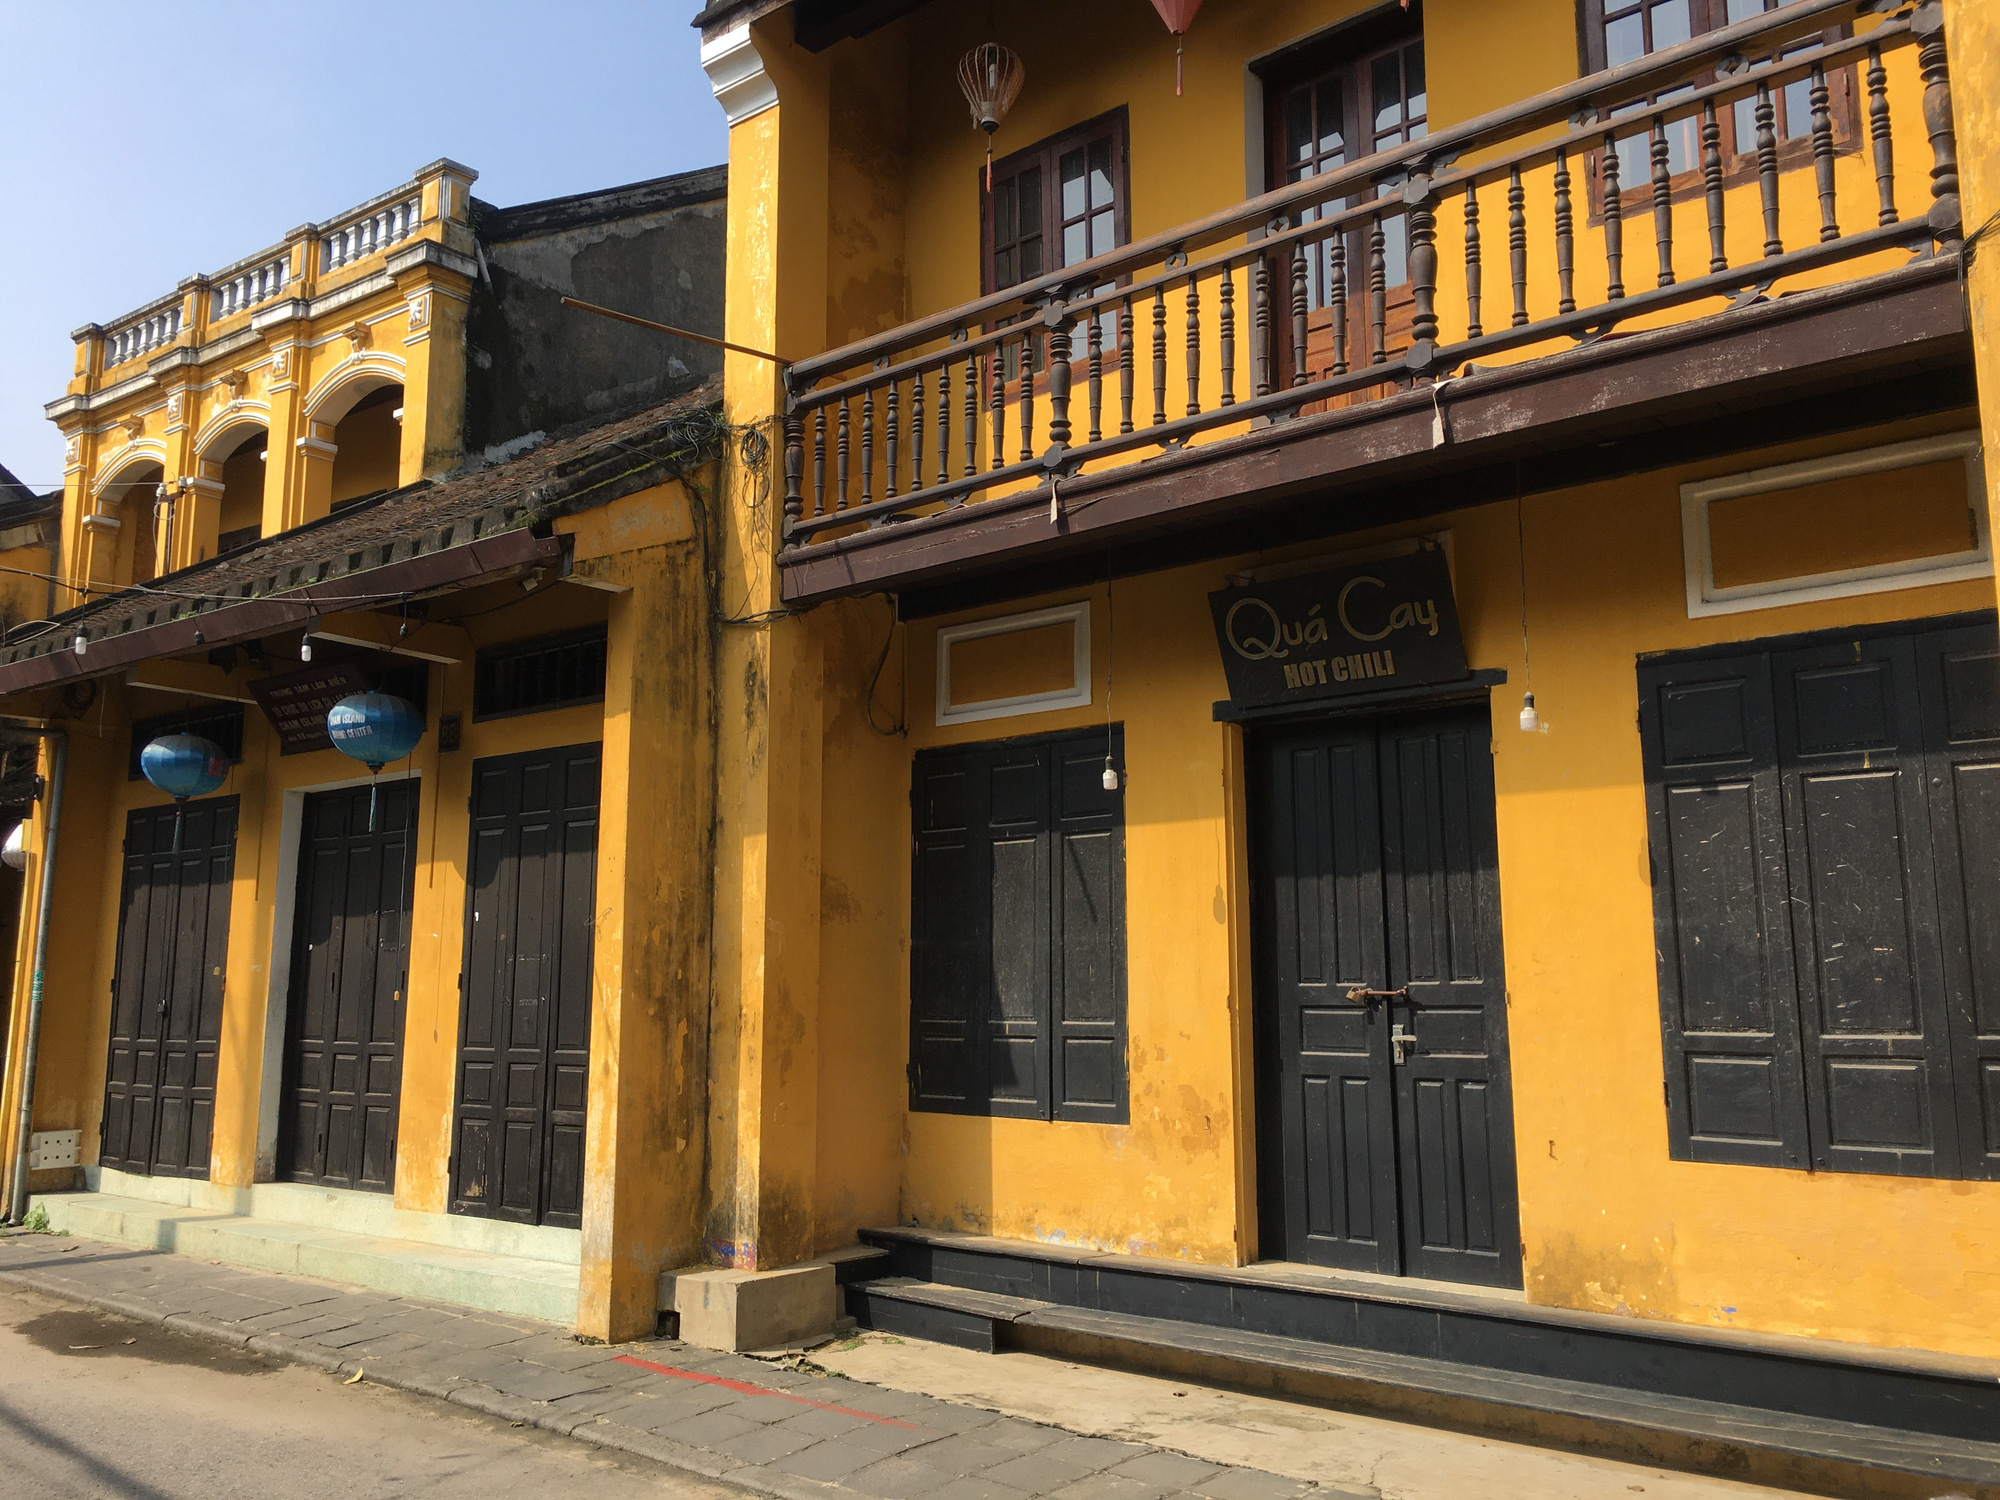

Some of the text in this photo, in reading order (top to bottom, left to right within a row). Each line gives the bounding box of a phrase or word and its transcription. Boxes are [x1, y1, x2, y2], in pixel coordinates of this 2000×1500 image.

[1225, 575, 1440, 661] Quá Cay
[1283, 650, 1396, 689] HOT CHILI
[300, 715, 326, 726] ISLAND
[342, 713, 366, 724] ISLAND
[347, 725, 373, 738] CENTER
